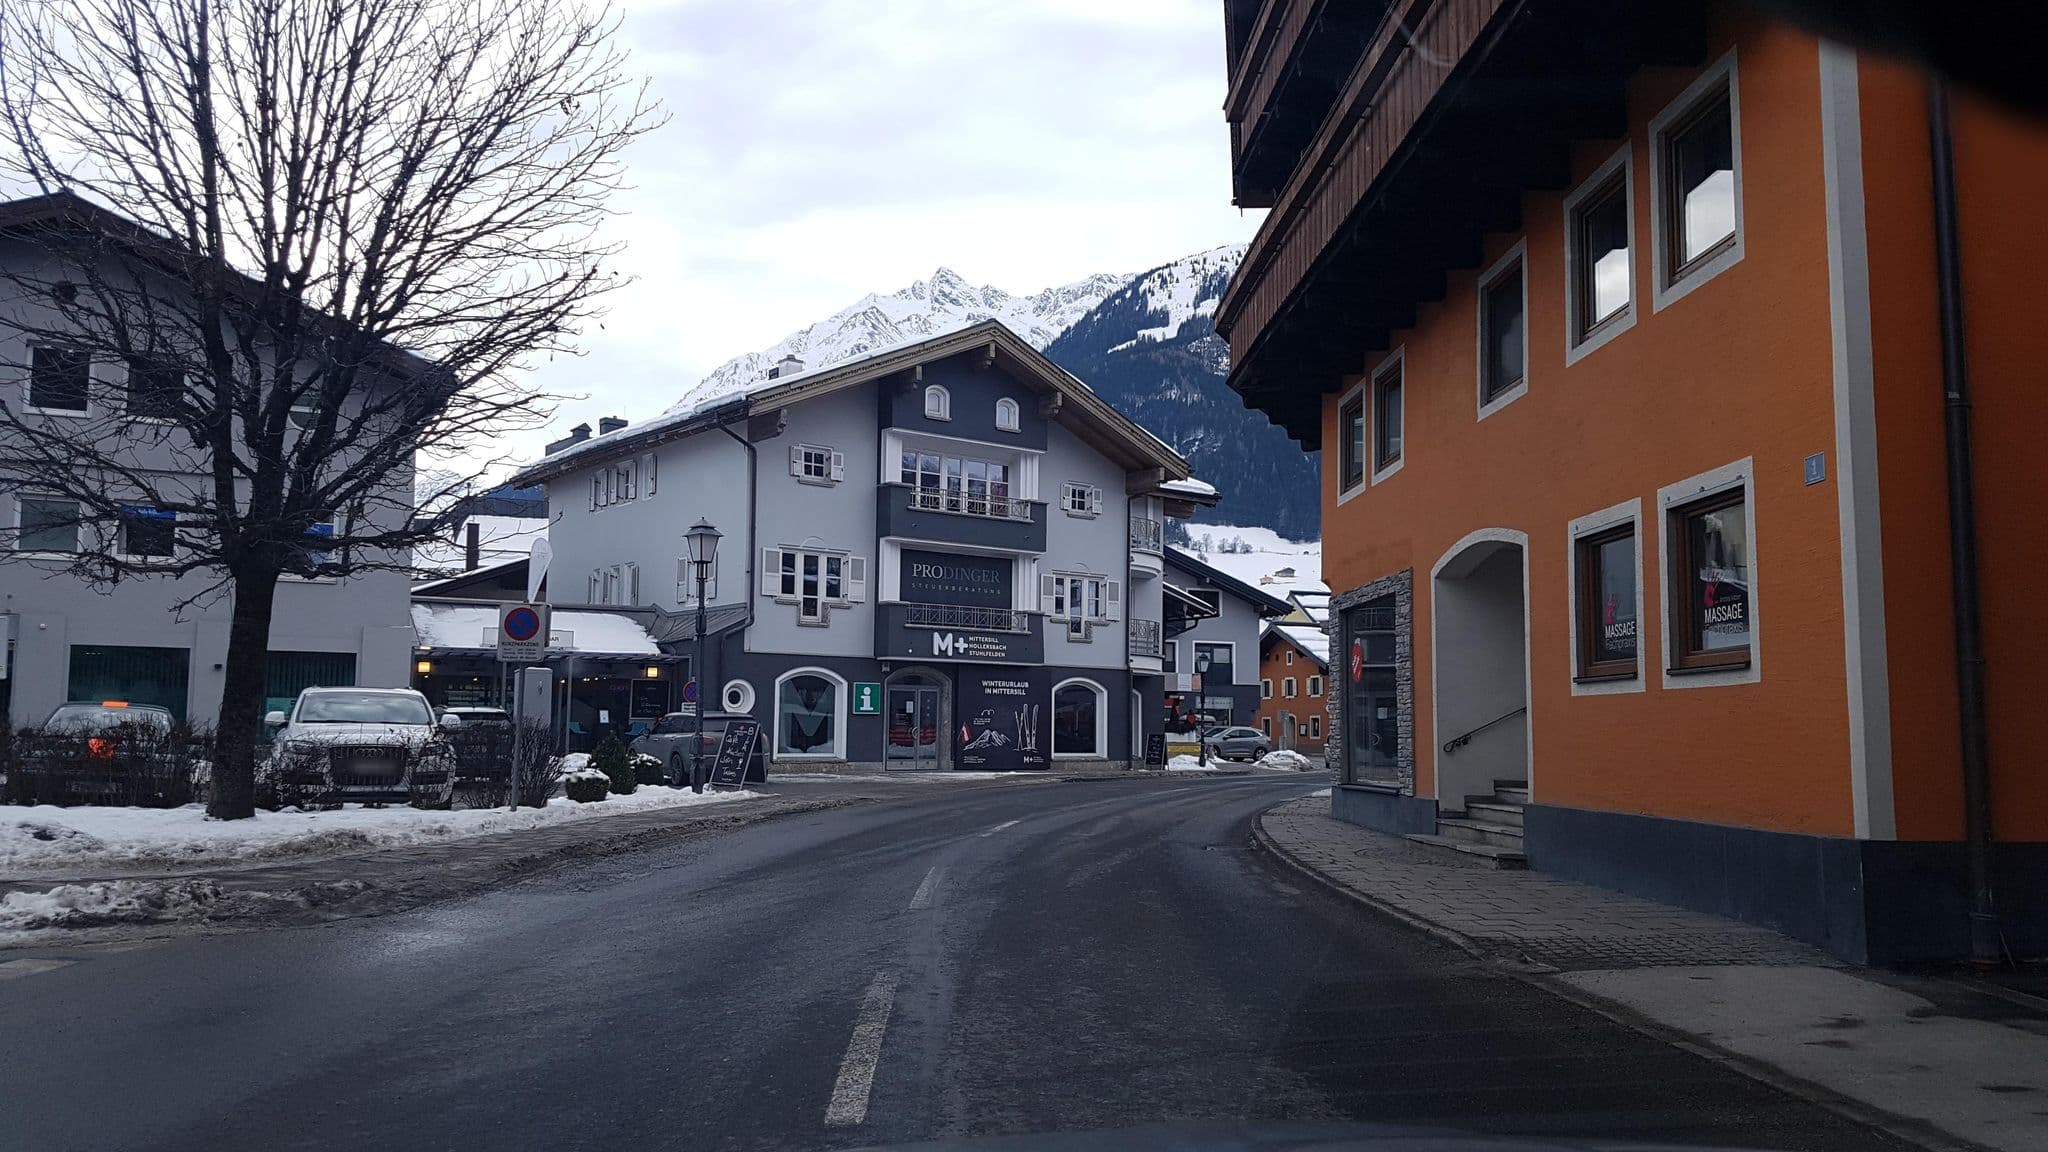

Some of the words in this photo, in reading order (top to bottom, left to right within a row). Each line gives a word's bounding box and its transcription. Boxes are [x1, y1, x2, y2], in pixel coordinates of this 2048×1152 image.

[912, 563, 1001, 584] PRODINGER
[911, 582, 1001, 595] STEUERBERATUNG
[1704, 602, 1743, 624] MASSAGE
[1605, 621, 1636, 639] MASSAGE
[981, 680, 1029, 688] WINTERURLAUB
[992, 688, 1026, 696] MITTERSILL
